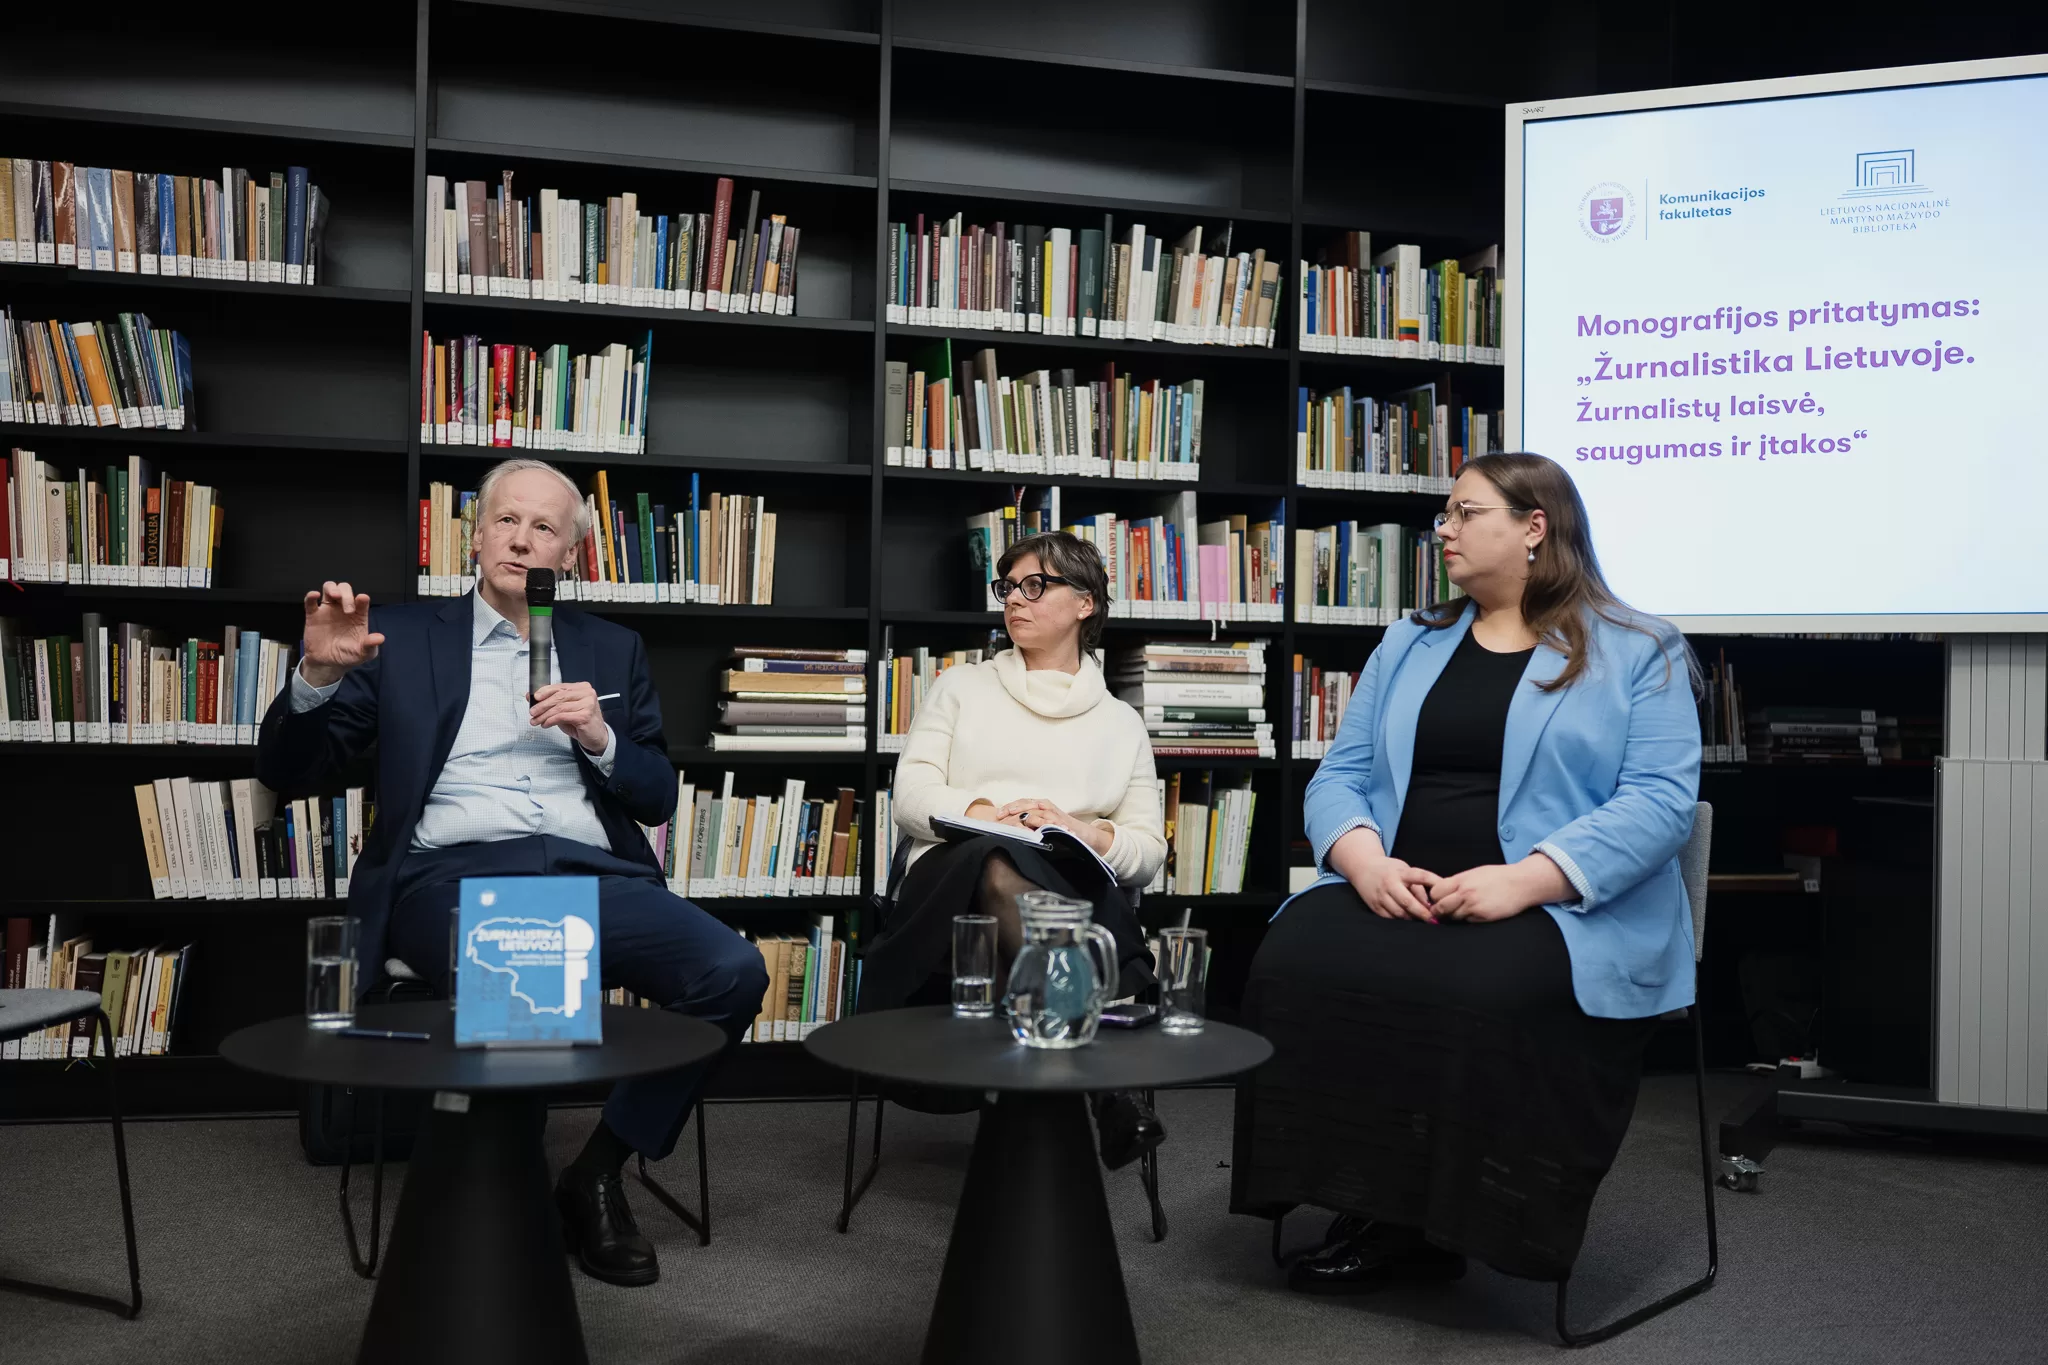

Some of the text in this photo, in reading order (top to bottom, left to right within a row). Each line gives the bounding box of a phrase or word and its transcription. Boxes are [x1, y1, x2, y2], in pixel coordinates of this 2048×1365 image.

[1659, 187, 1766, 204] Komunikacijos
[1820, 197, 1951, 216] LIETUVOS NACIONALINĖ
[1659, 207, 1732, 220] fakultetas
[1830, 210, 1941, 225] MARTYNO MAŽVYDO
[1852, 222, 1917, 234] BIBLIOTEKA
[713, 227, 722, 257] KATEDROS
[1578, 299, 1979, 338] Monografijos pritatymas:
[1577, 340, 1974, 387] „Žurnalistika Lietuvoje.
[1577, 392, 1824, 423] Žurnalistų laisvė,
[1576, 430, 1867, 465] saugumas ir įtakos“
[53, 517, 61, 562] AGAVADGYTA
[148, 515, 158, 565] EVO KALBA
[1235, 747, 1258, 755] ŠIANDI
